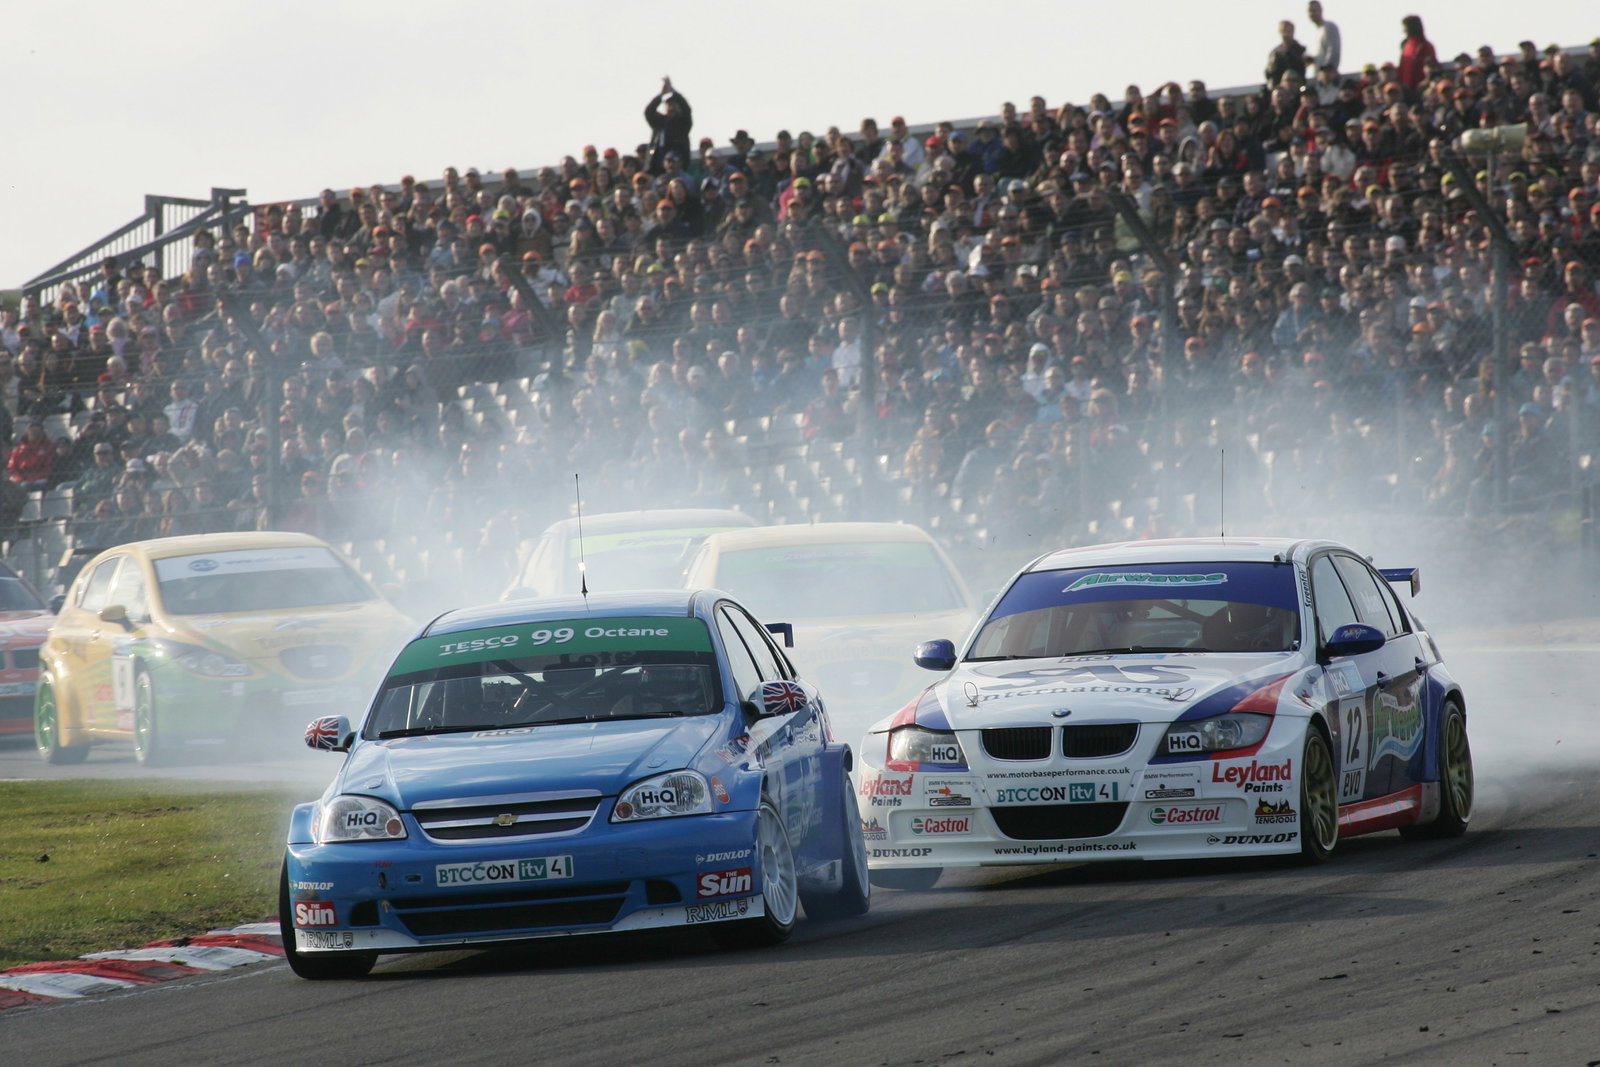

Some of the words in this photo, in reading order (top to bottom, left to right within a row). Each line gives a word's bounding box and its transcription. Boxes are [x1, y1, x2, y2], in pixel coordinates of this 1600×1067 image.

[1062, 572, 1227, 592] Airwaves
[440, 634, 519, 654] TESCO
[531, 627, 575, 645] 99
[585, 627, 669, 638] Octane
[1170, 734, 1200, 750] HiQ
[1346, 706, 1362, 764] 12
[932, 746, 958, 761] HiQ
[987, 767, 1130, 779] www.motorbaseperformance.co.uk
[1212, 759, 1292, 788] Leyland
[859, 774, 914, 801] Leyland
[1072, 786, 1093, 800] itv
[1244, 782, 1284, 793] Paints
[641, 789, 675, 804] HiQ
[872, 796, 902, 807] Paints
[347, 812, 378, 827] HiQ
[1167, 806, 1221, 823] Castrol
[924, 817, 969, 833] Castrol
[1222, 832, 1298, 845] DUNLOP
[706, 849, 751, 863] DUNLOP
[872, 847, 932, 858] DUNLOP
[994, 841, 1137, 855] www.leyland-paints.co.uk
[520, 861, 545, 877] itv
[298, 882, 334, 890] DUNLOP
[698, 874, 751, 897] Sun
[296, 903, 335, 926] Sun
[686, 903, 738, 924] RML
[305, 932, 344, 949] RML
